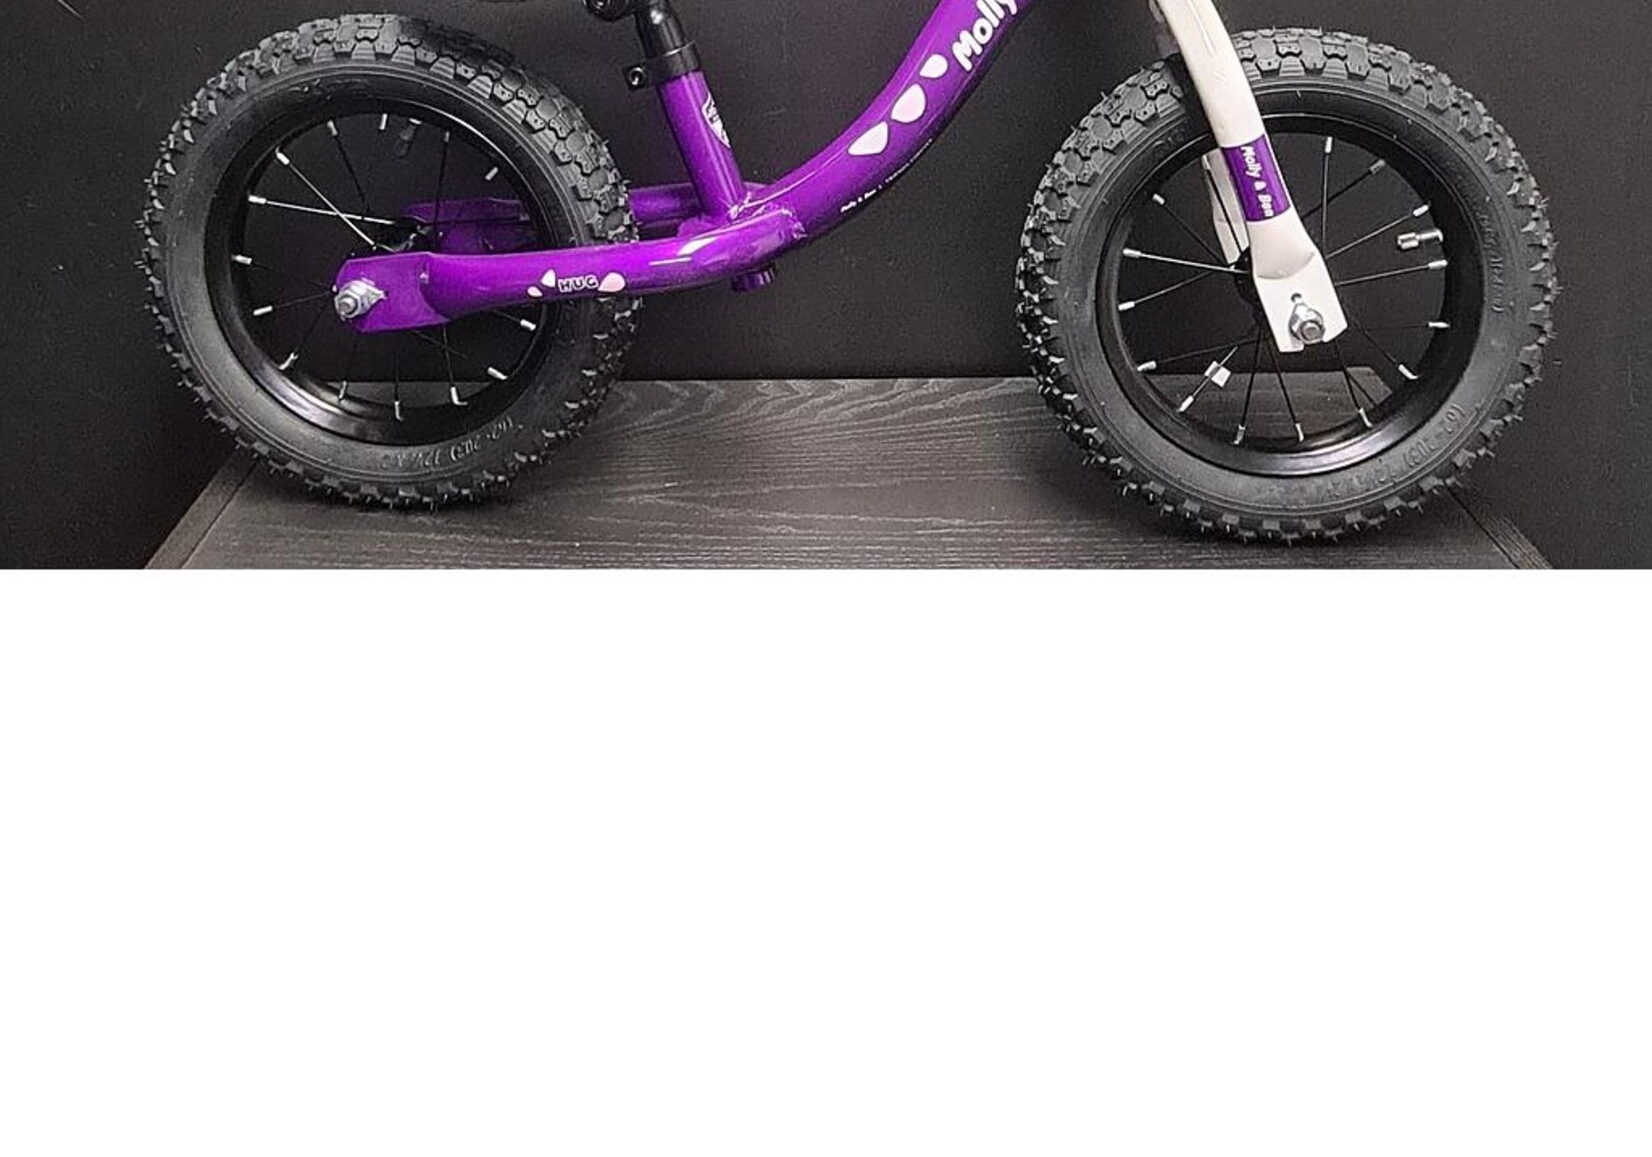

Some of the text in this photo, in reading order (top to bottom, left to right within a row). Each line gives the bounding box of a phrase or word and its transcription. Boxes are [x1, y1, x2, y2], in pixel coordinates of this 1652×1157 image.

[1240, 146, 1263, 178] Molly
[1258, 194, 1274, 217] Ben
[557, 274, 600, 293] HUG
